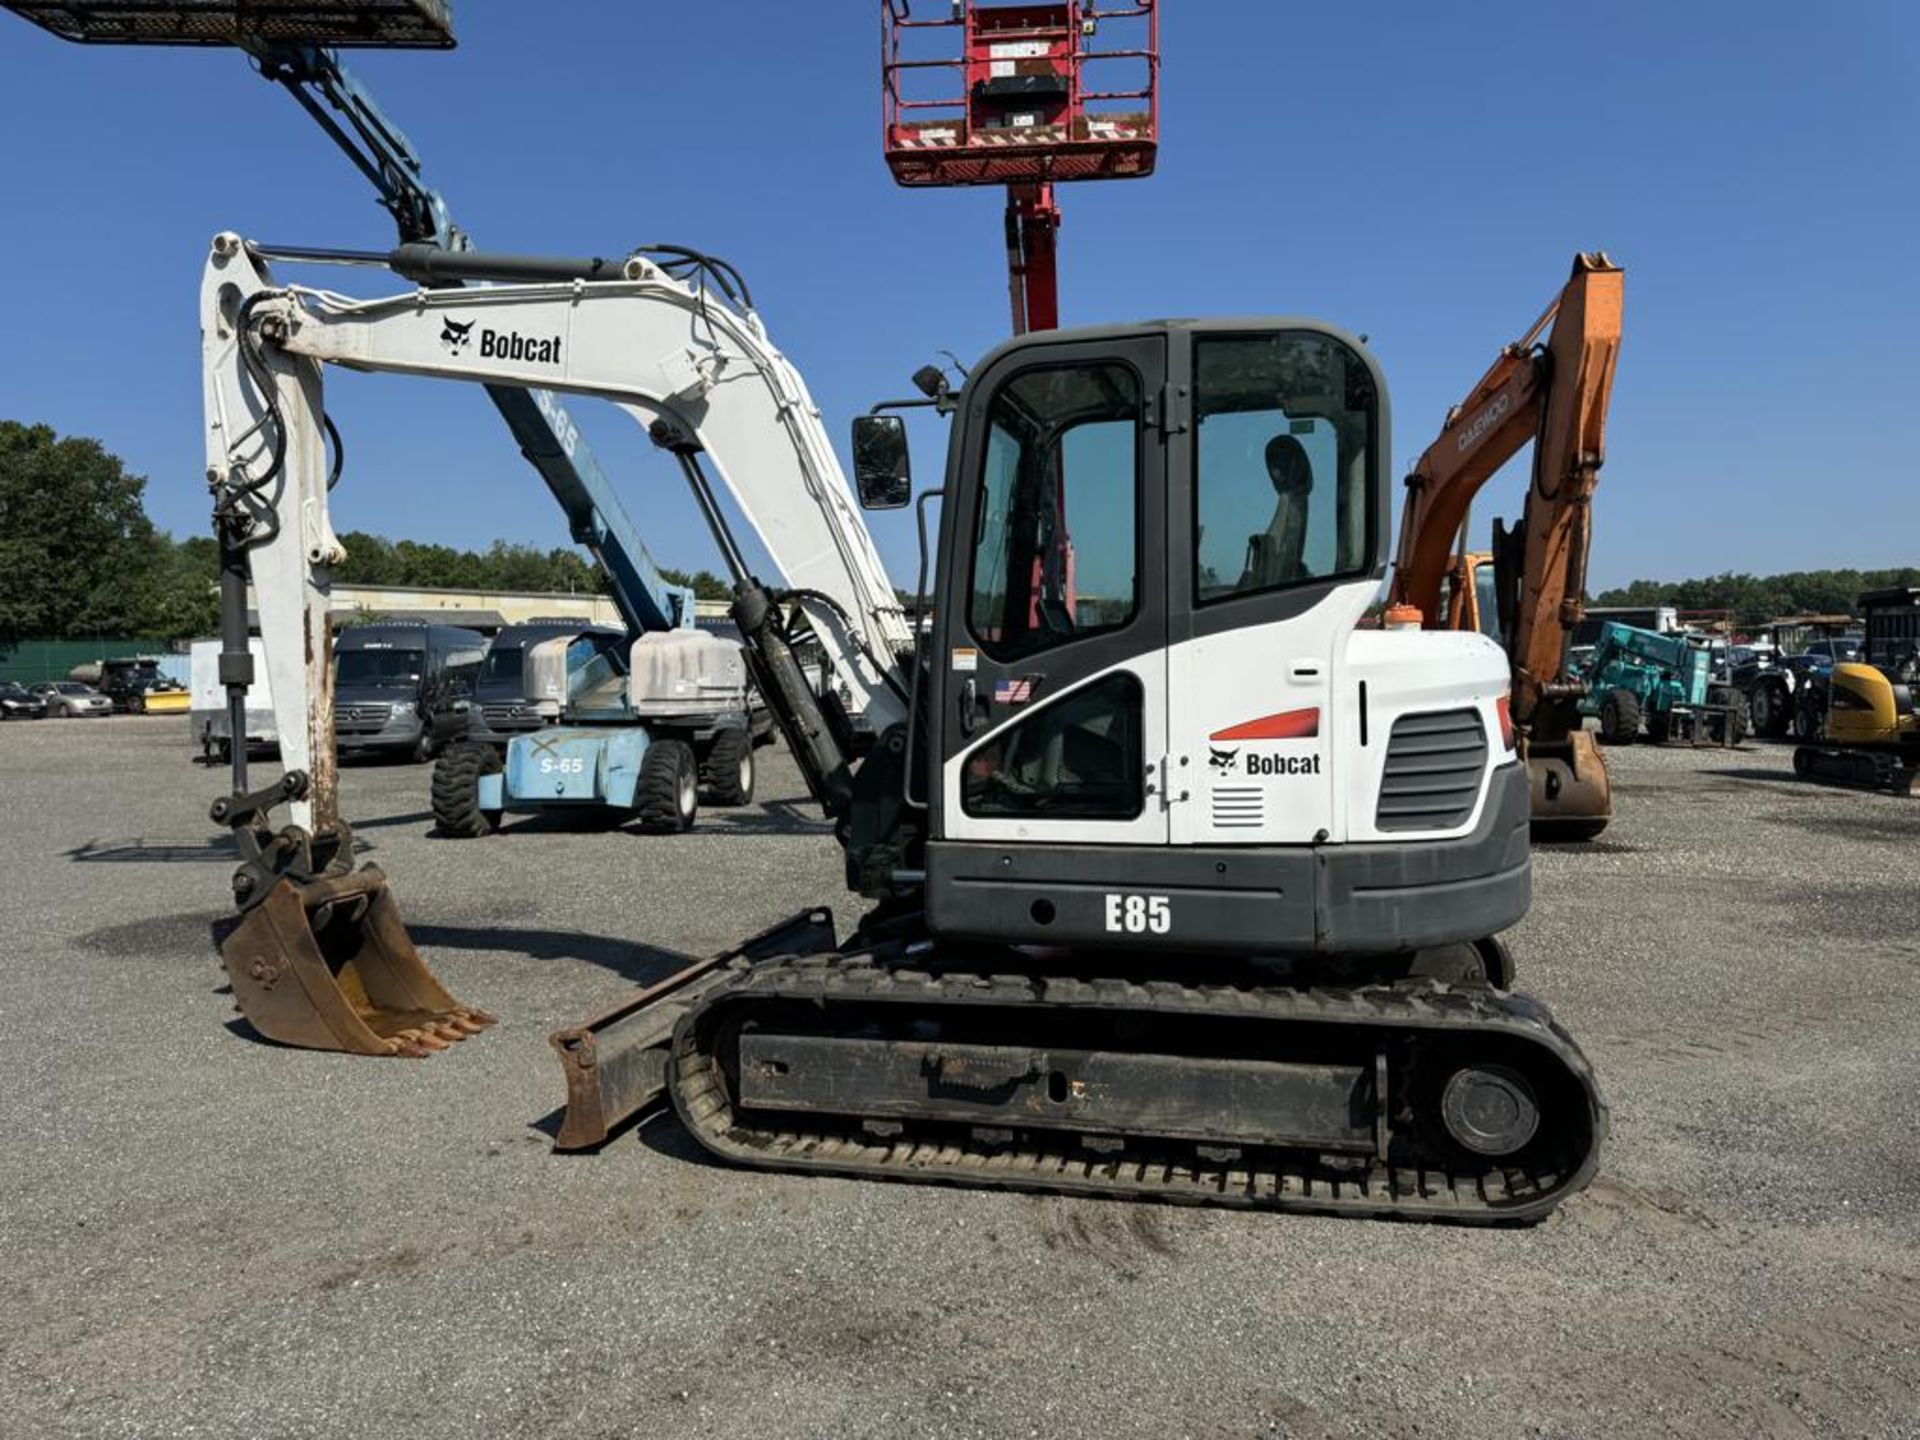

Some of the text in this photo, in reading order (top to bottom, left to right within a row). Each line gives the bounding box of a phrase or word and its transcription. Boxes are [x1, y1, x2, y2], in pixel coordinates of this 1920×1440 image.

[480, 329, 561, 364] Bobcat
[1458, 394, 1508, 450] DAEWOO
[540, 757, 584, 773] S-65
[1246, 753, 1321, 775] Bobcat
[1104, 894, 1171, 934] E85
